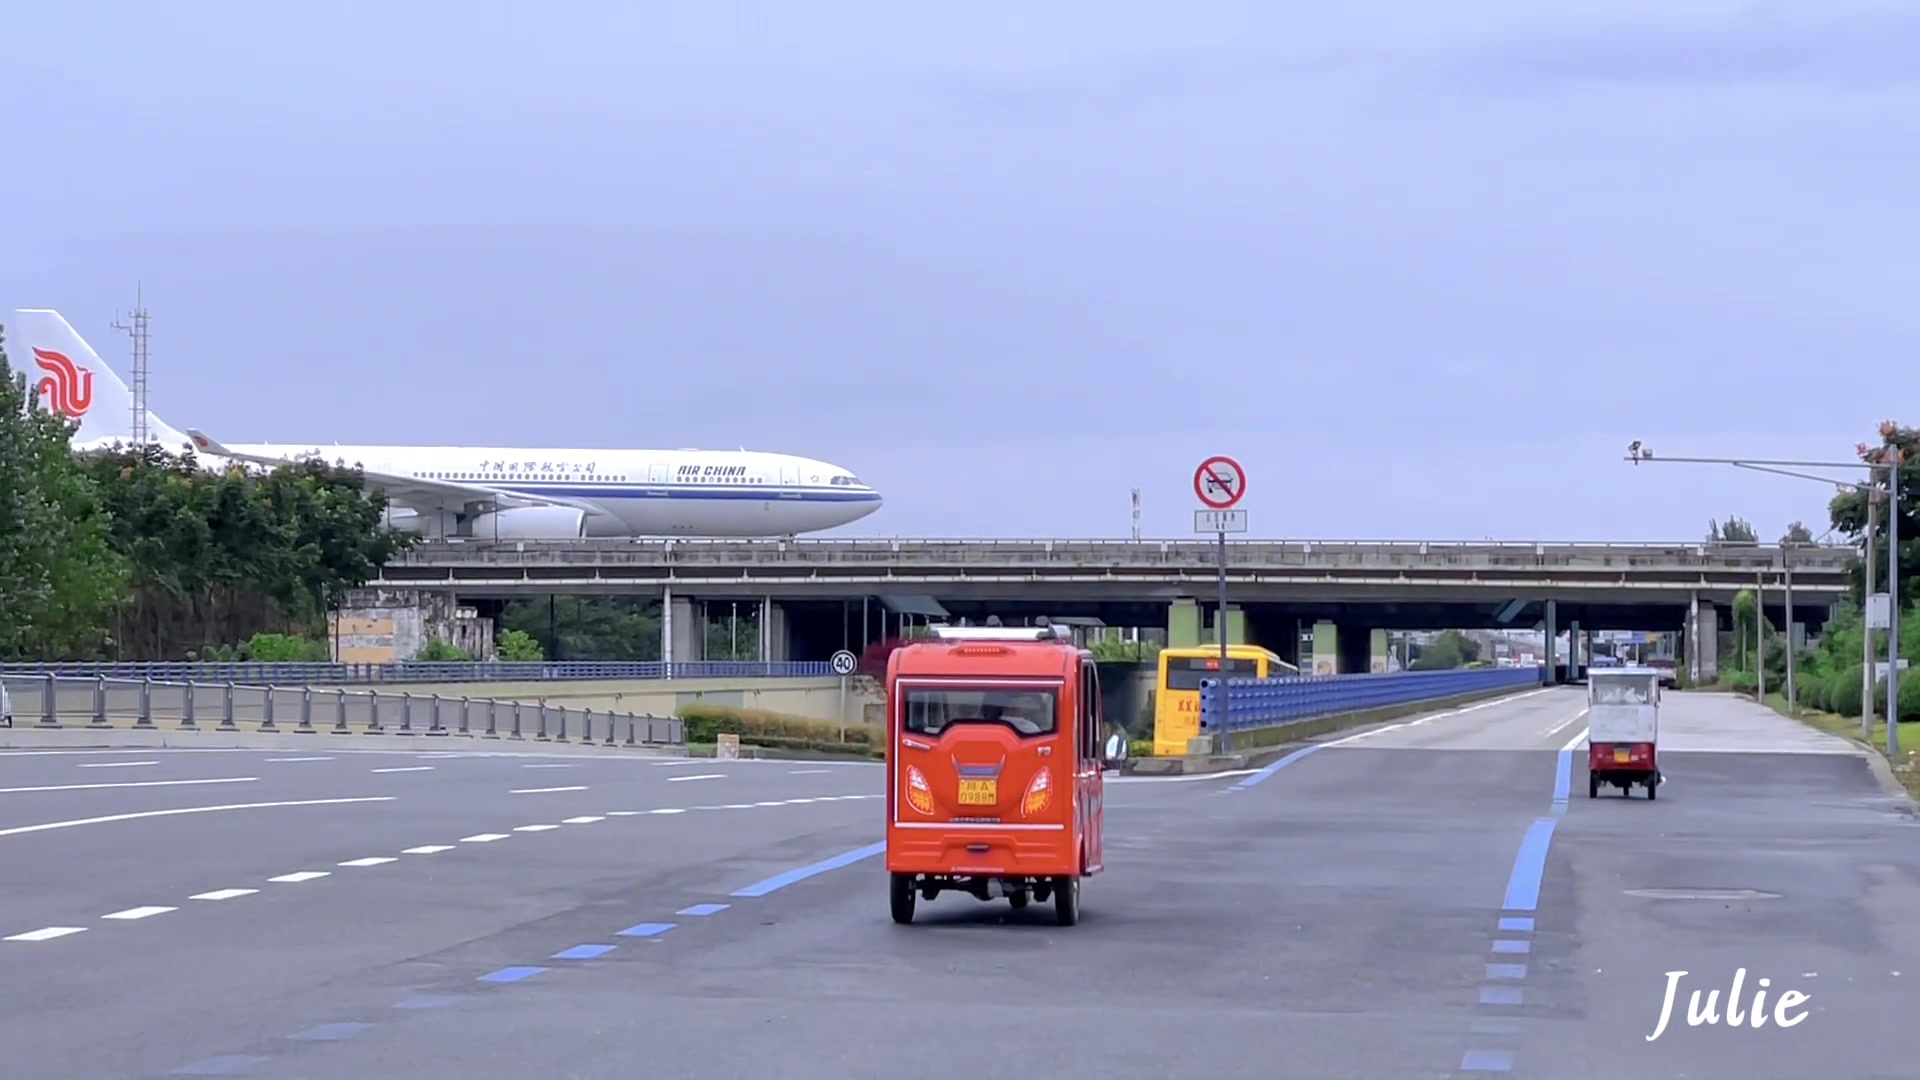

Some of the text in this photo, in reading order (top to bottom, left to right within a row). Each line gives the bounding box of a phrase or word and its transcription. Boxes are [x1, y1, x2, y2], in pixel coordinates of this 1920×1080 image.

[677, 465, 747, 476] AIR CHINA
[836, 656, 851, 670] 40
